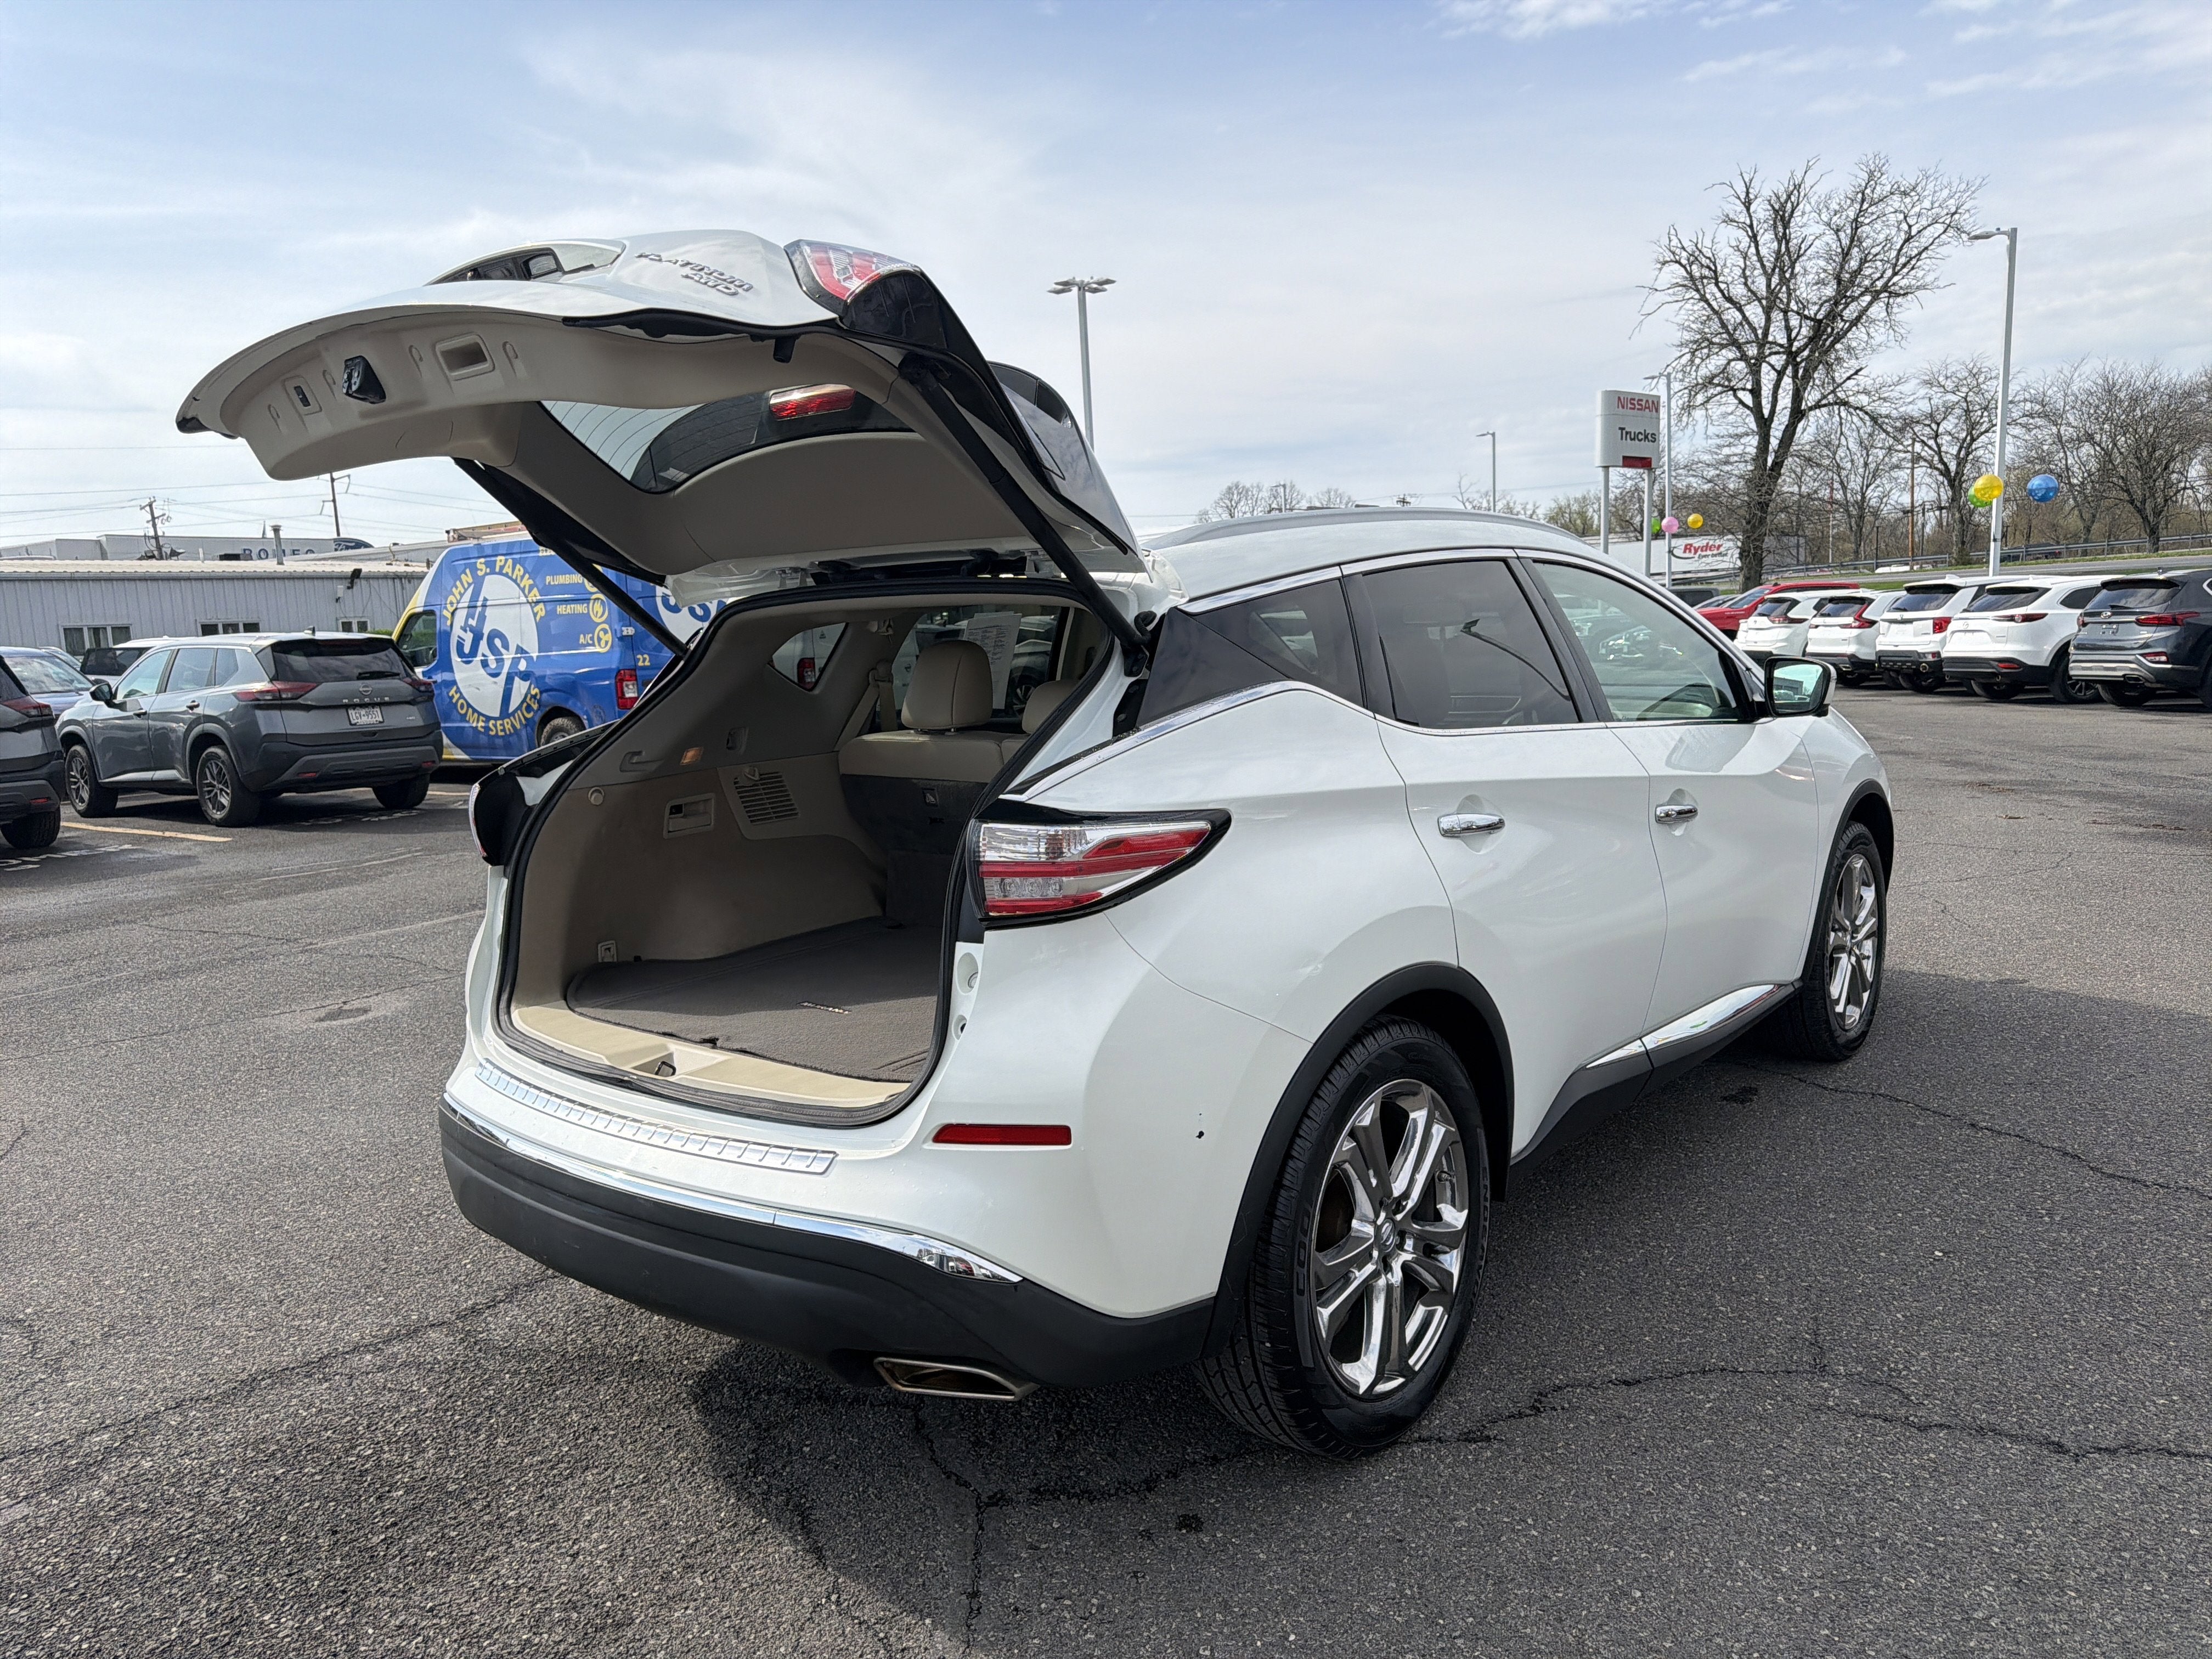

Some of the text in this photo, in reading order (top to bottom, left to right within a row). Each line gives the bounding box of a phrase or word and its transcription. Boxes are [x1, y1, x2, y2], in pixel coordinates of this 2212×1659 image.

[680, 273, 739, 296] AWD
[1617, 396, 1659, 413] NISSAN
[1618, 426, 1657, 443] Trucks
[1683, 541, 1723, 555] Ryder
[546, 573, 583, 585] PLUMBING
[442, 555, 546, 627] JOHN S. PARKER
[557, 603, 588, 614] HEATING
[579, 634, 593, 645] A/C
[636, 654, 651, 667] 22
[449, 684, 541, 737] HOME SERVICES
